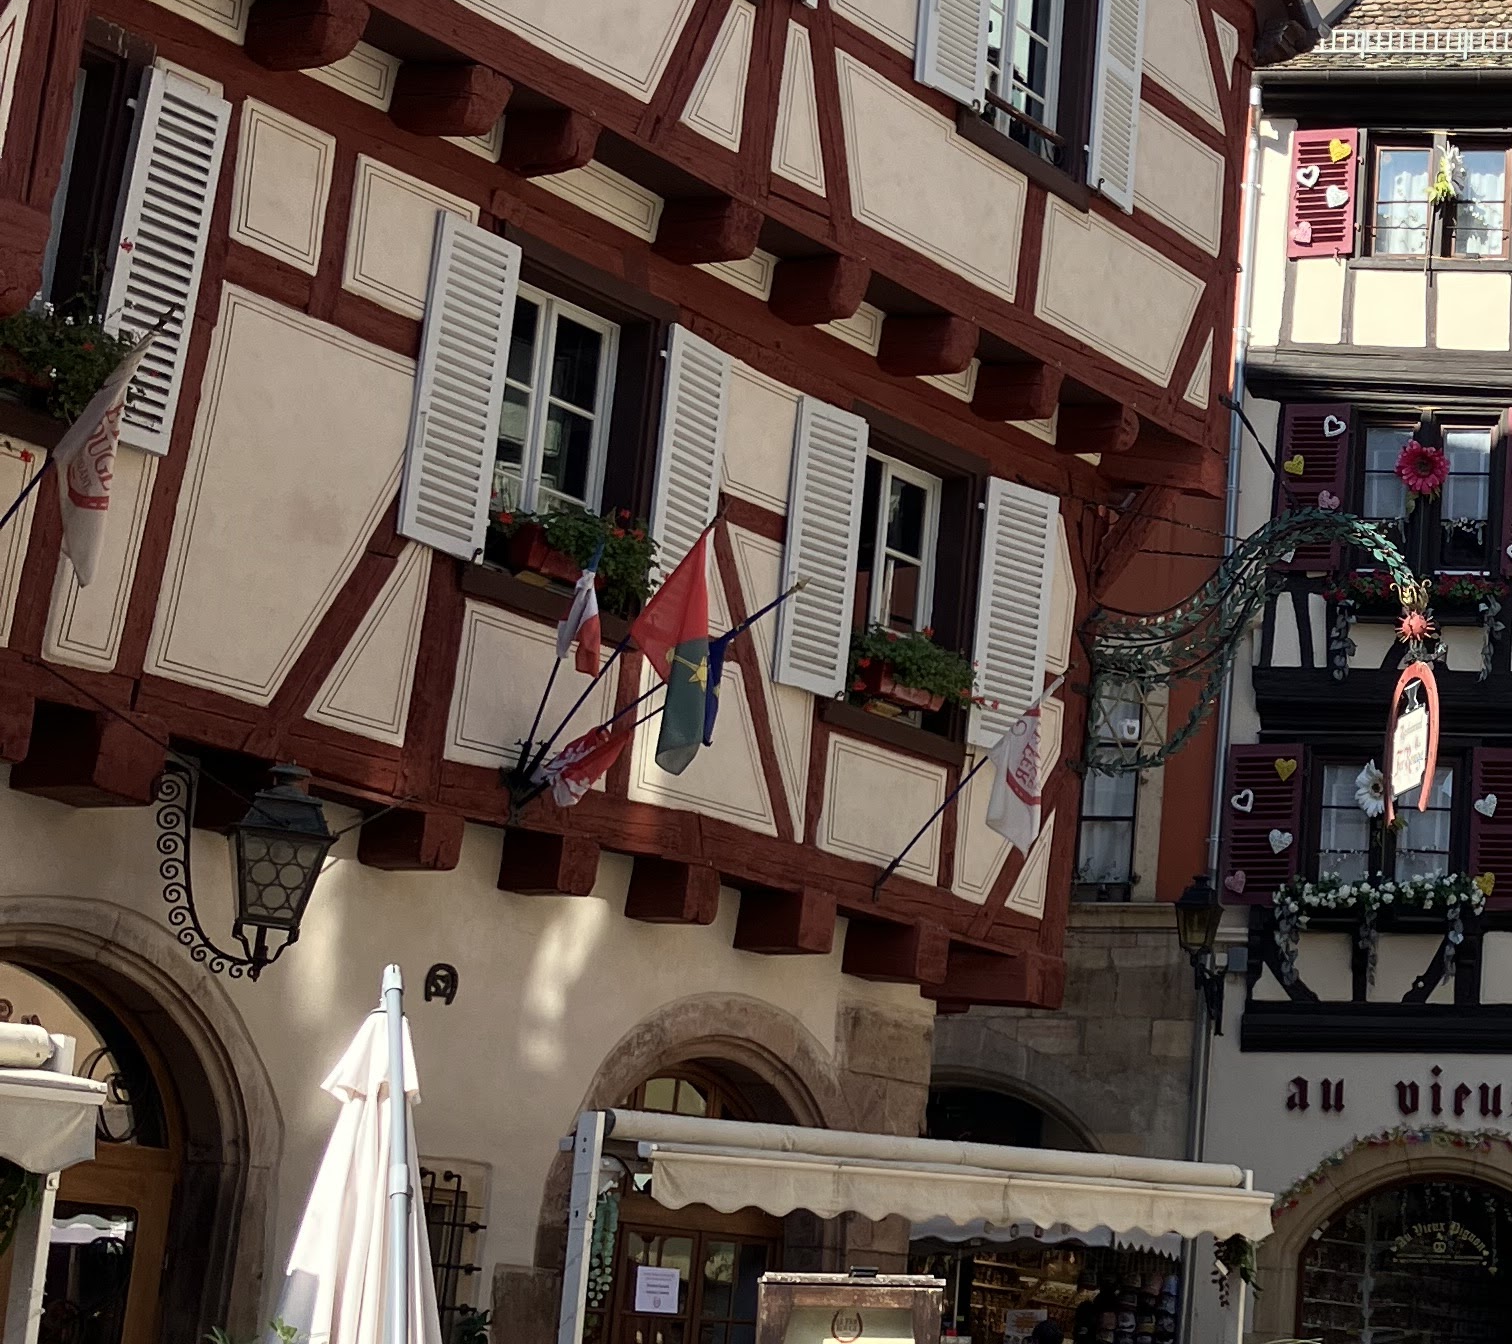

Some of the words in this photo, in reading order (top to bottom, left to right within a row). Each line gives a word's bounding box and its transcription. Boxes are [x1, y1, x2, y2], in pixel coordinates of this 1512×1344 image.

[1285, 1075, 1346, 1113] au
[1394, 1232, 1413, 1249] Au
[1411, 1222, 1446, 1236] Vieux
[1449, 1221, 1486, 1252] Pignon
